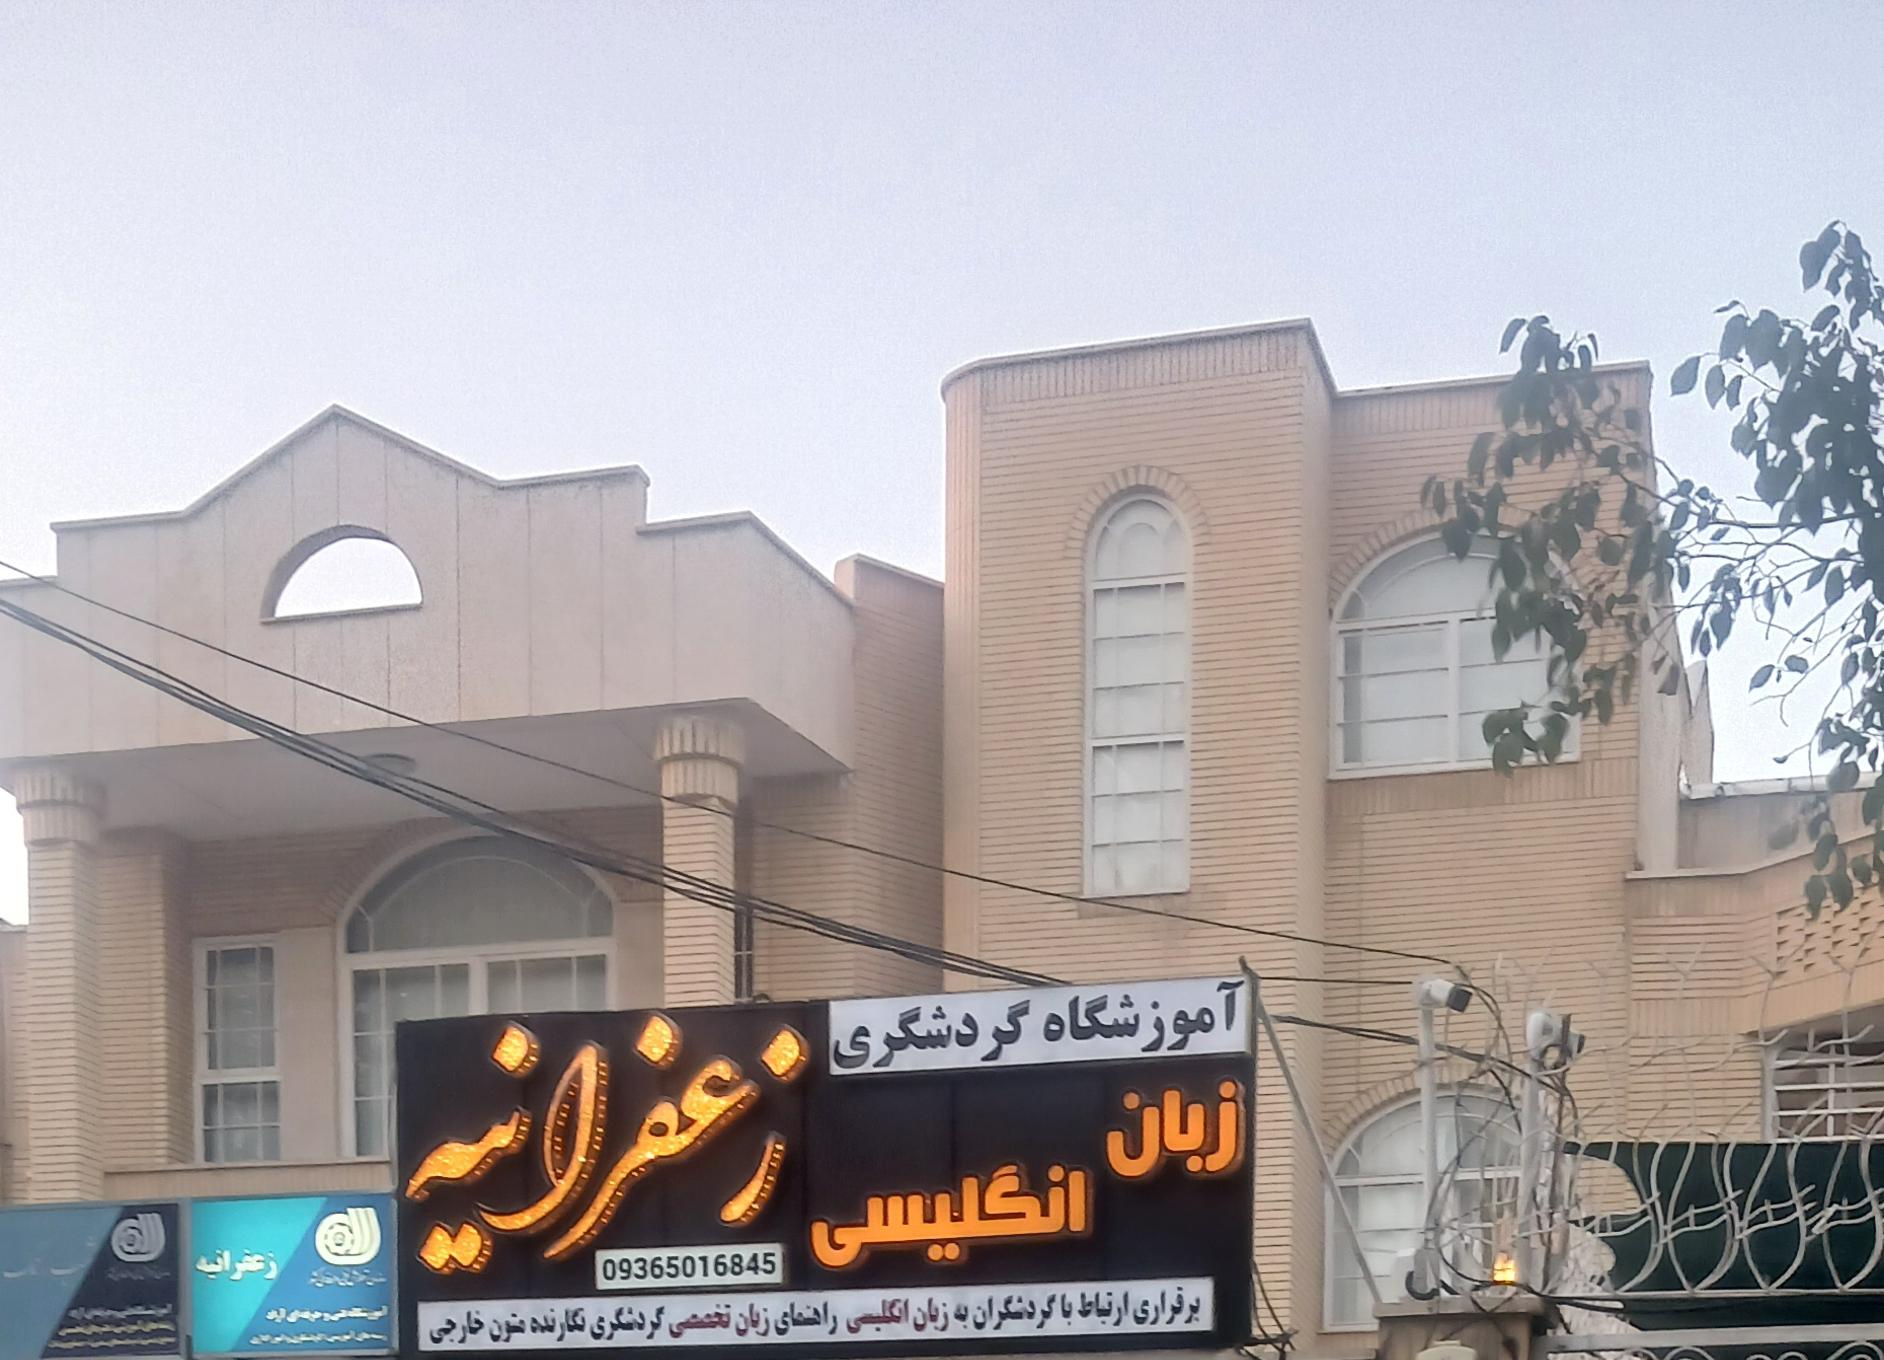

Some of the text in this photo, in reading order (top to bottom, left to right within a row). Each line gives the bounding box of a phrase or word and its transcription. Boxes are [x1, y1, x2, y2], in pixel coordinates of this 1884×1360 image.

[832, 980, 1245, 1070] آموزشگاه گردشگری
[404, 1012, 810, 1275] زعفرانیه
[1105, 1078, 1245, 1179] زبان
[809, 1163, 1088, 1268] انگلیسی
[195, 1248, 280, 1281] زعفرانیه
[602, 1252, 777, 1281] 09365016845
[589, 1305, 666, 1341] گردشگری
[668, 1303, 731, 1340] تخصصی
[735, 1302, 771, 1338] زبان
[774, 1299, 838, 1337] راهنمای
[845, 1298, 910, 1335] انگلیسی
[912, 1298, 949, 1334] زبان
[952, 1302, 969, 1330] به
[972, 1293, 1058, 1330] گردشگران
[1060, 1295, 1073, 1327] با
[1077, 1291, 1129, 1328] ارتباط
[1132, 1286, 1201, 1326] برقراری
[429, 1309, 483, 1345] خارجی
[488, 1312, 527, 1343] متون
[529, 1307, 586, 1343] نگارنده
